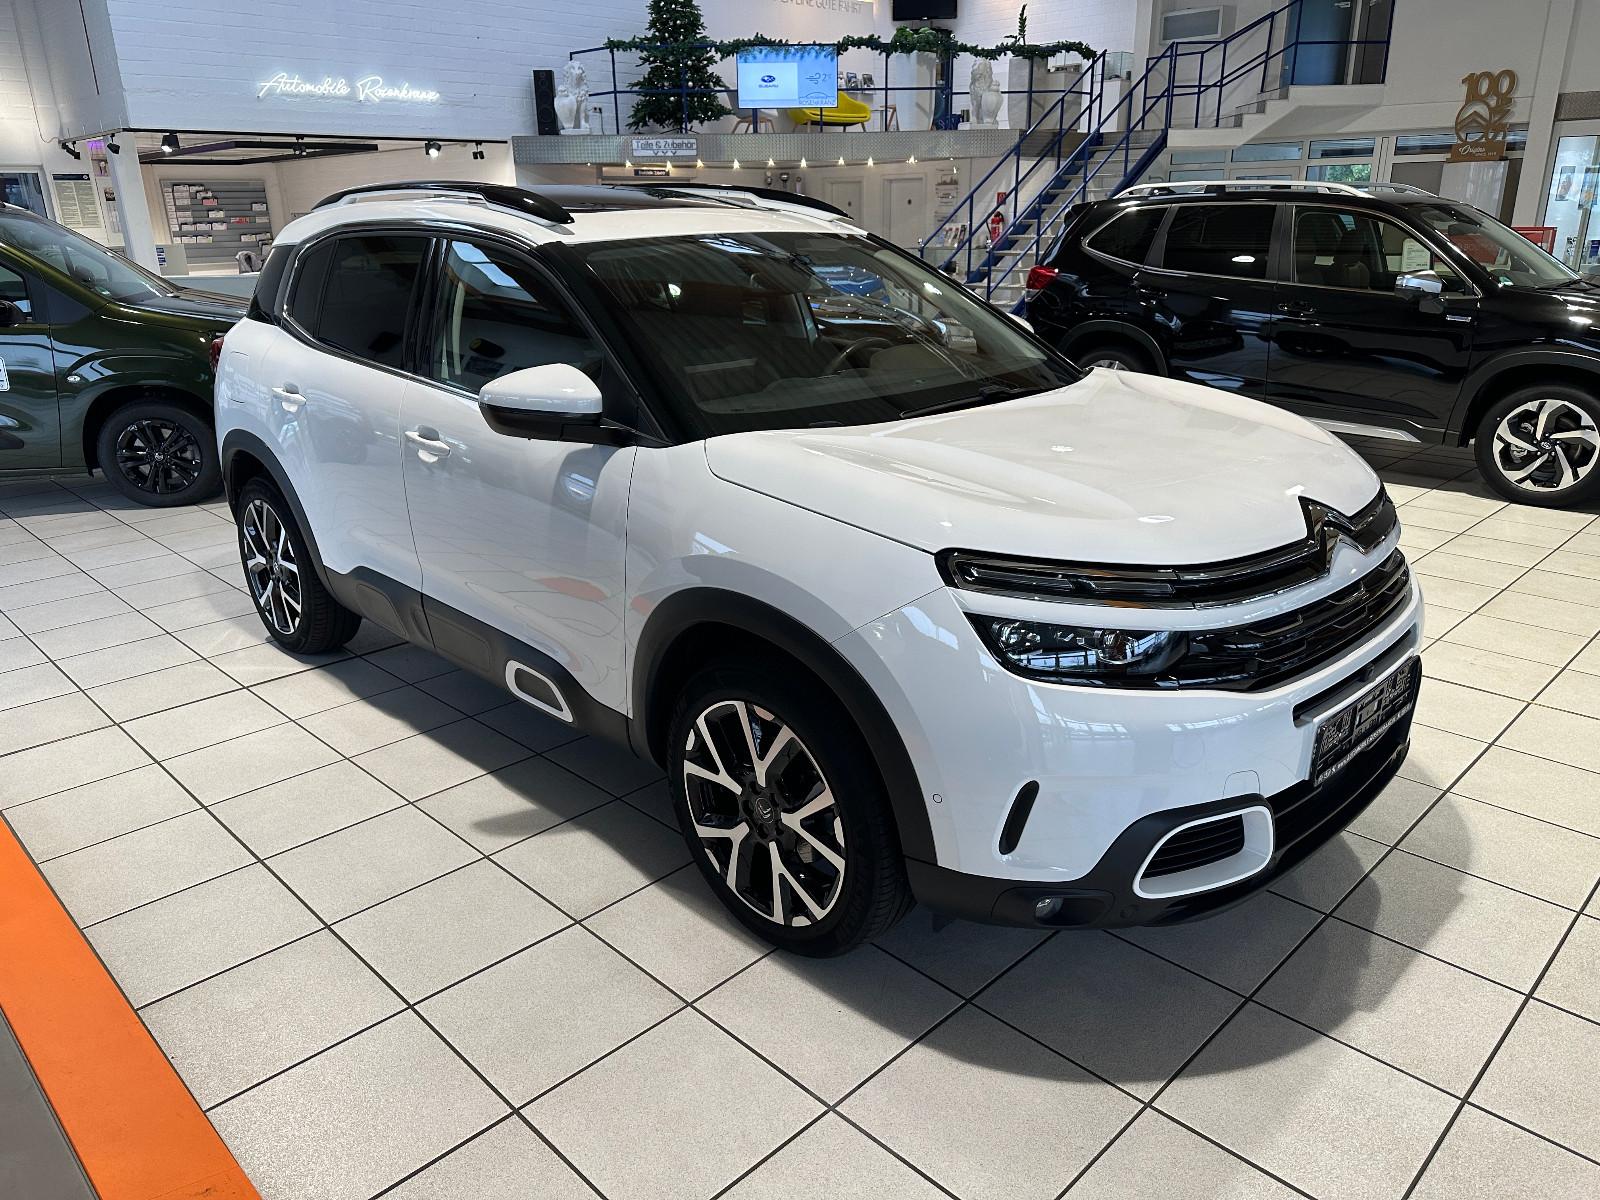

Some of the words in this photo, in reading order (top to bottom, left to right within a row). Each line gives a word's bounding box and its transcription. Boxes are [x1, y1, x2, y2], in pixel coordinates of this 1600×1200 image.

[257, 73, 350, 98] Automobile
[1462, 69, 1518, 104] 100
[635, 141, 654, 149] Teile
